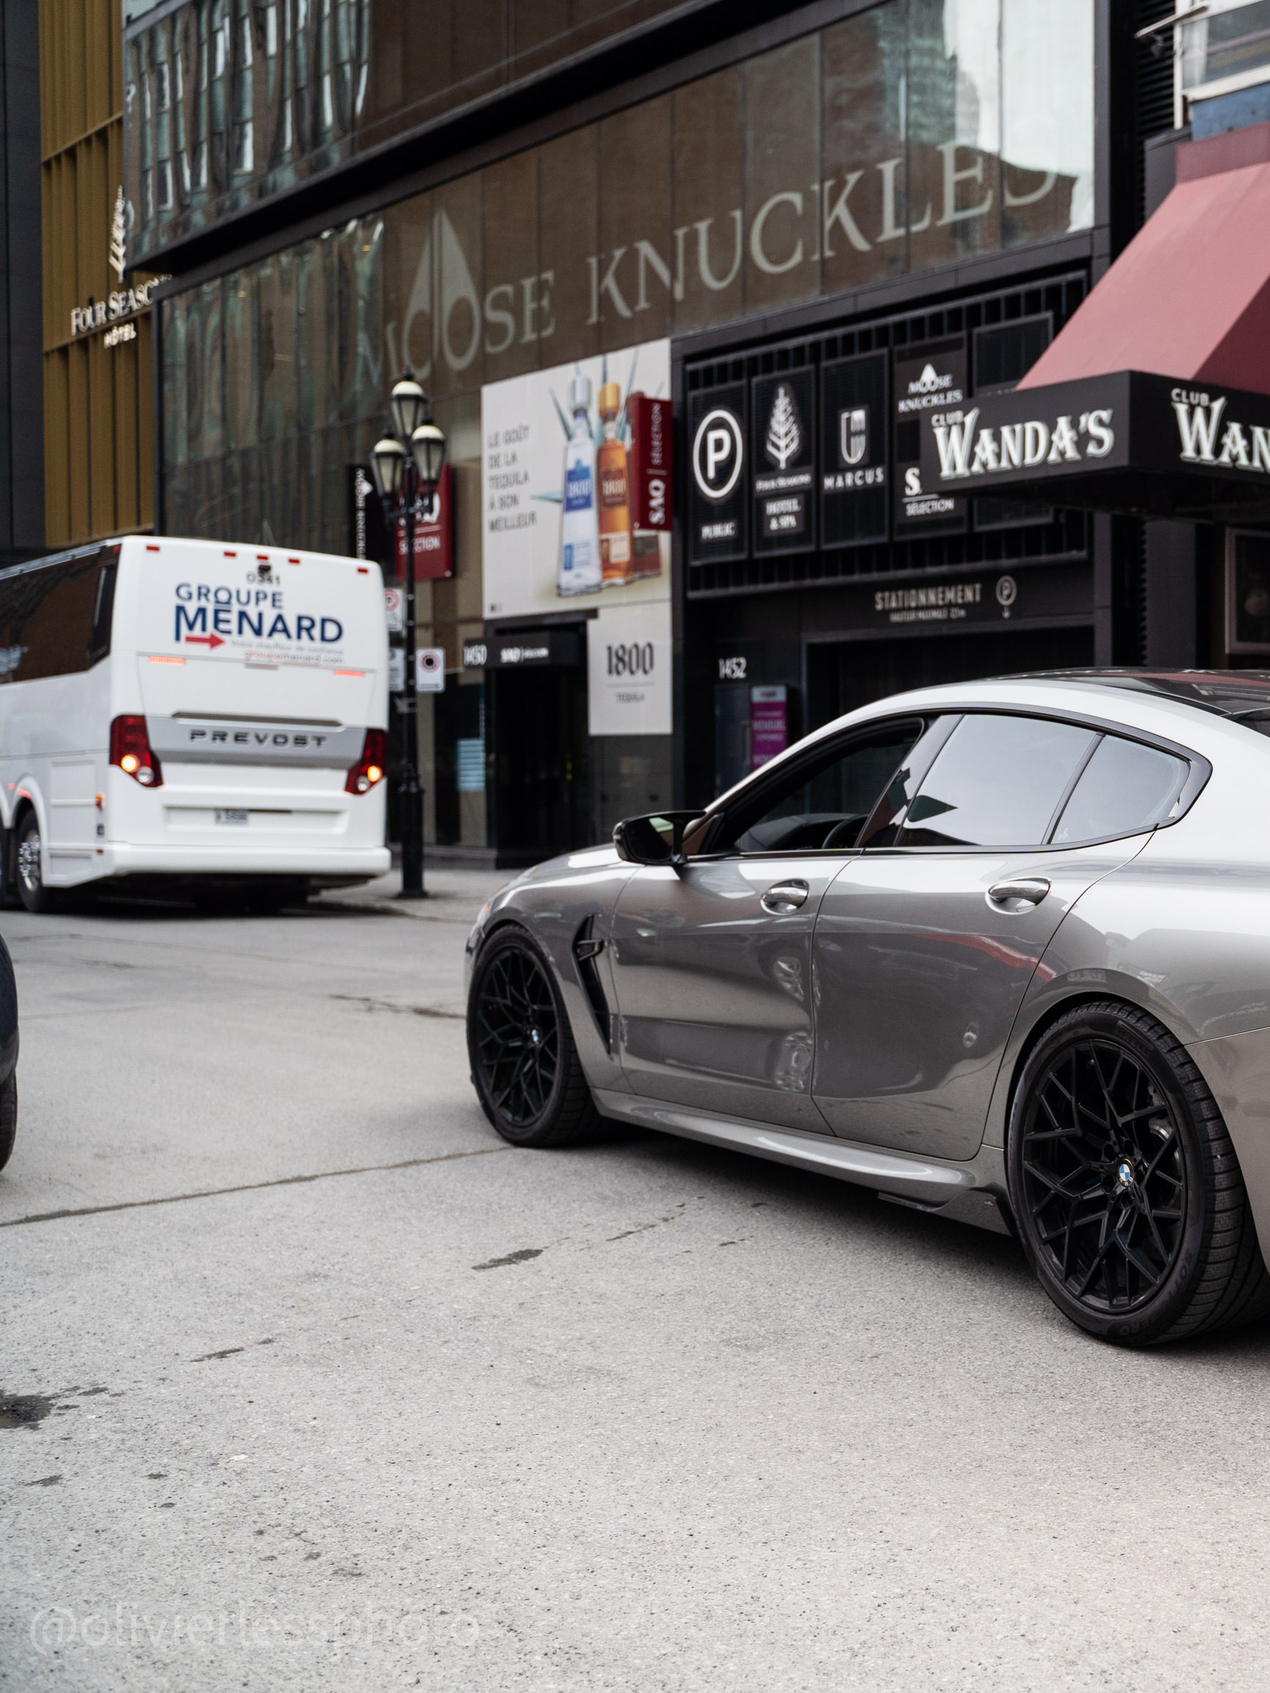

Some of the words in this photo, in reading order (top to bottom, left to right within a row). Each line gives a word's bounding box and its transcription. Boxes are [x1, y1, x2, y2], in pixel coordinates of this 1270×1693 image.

[71, 300, 107, 336] FOUR
[108, 273, 172, 320] SEASO
[908, 368, 953, 394] MOOSE
[898, 389, 963, 413] KNUCKLES
[1171, 388, 1210, 406] CLUB
[931, 410, 964, 428] CLUB
[933, 407, 1116, 481] WANDA'S
[823, 467, 885, 491] MARCUS
[648, 478, 666, 526] SAQ
[488, 511, 538, 534] MEILLEUR
[175, 583, 284, 609] GROUPE
[874, 582, 982, 611] STATIONNEMENT
[606, 642, 655, 677] 1800
[718, 656, 747, 680] 1452
[190, 729, 327, 747] PREVOST
